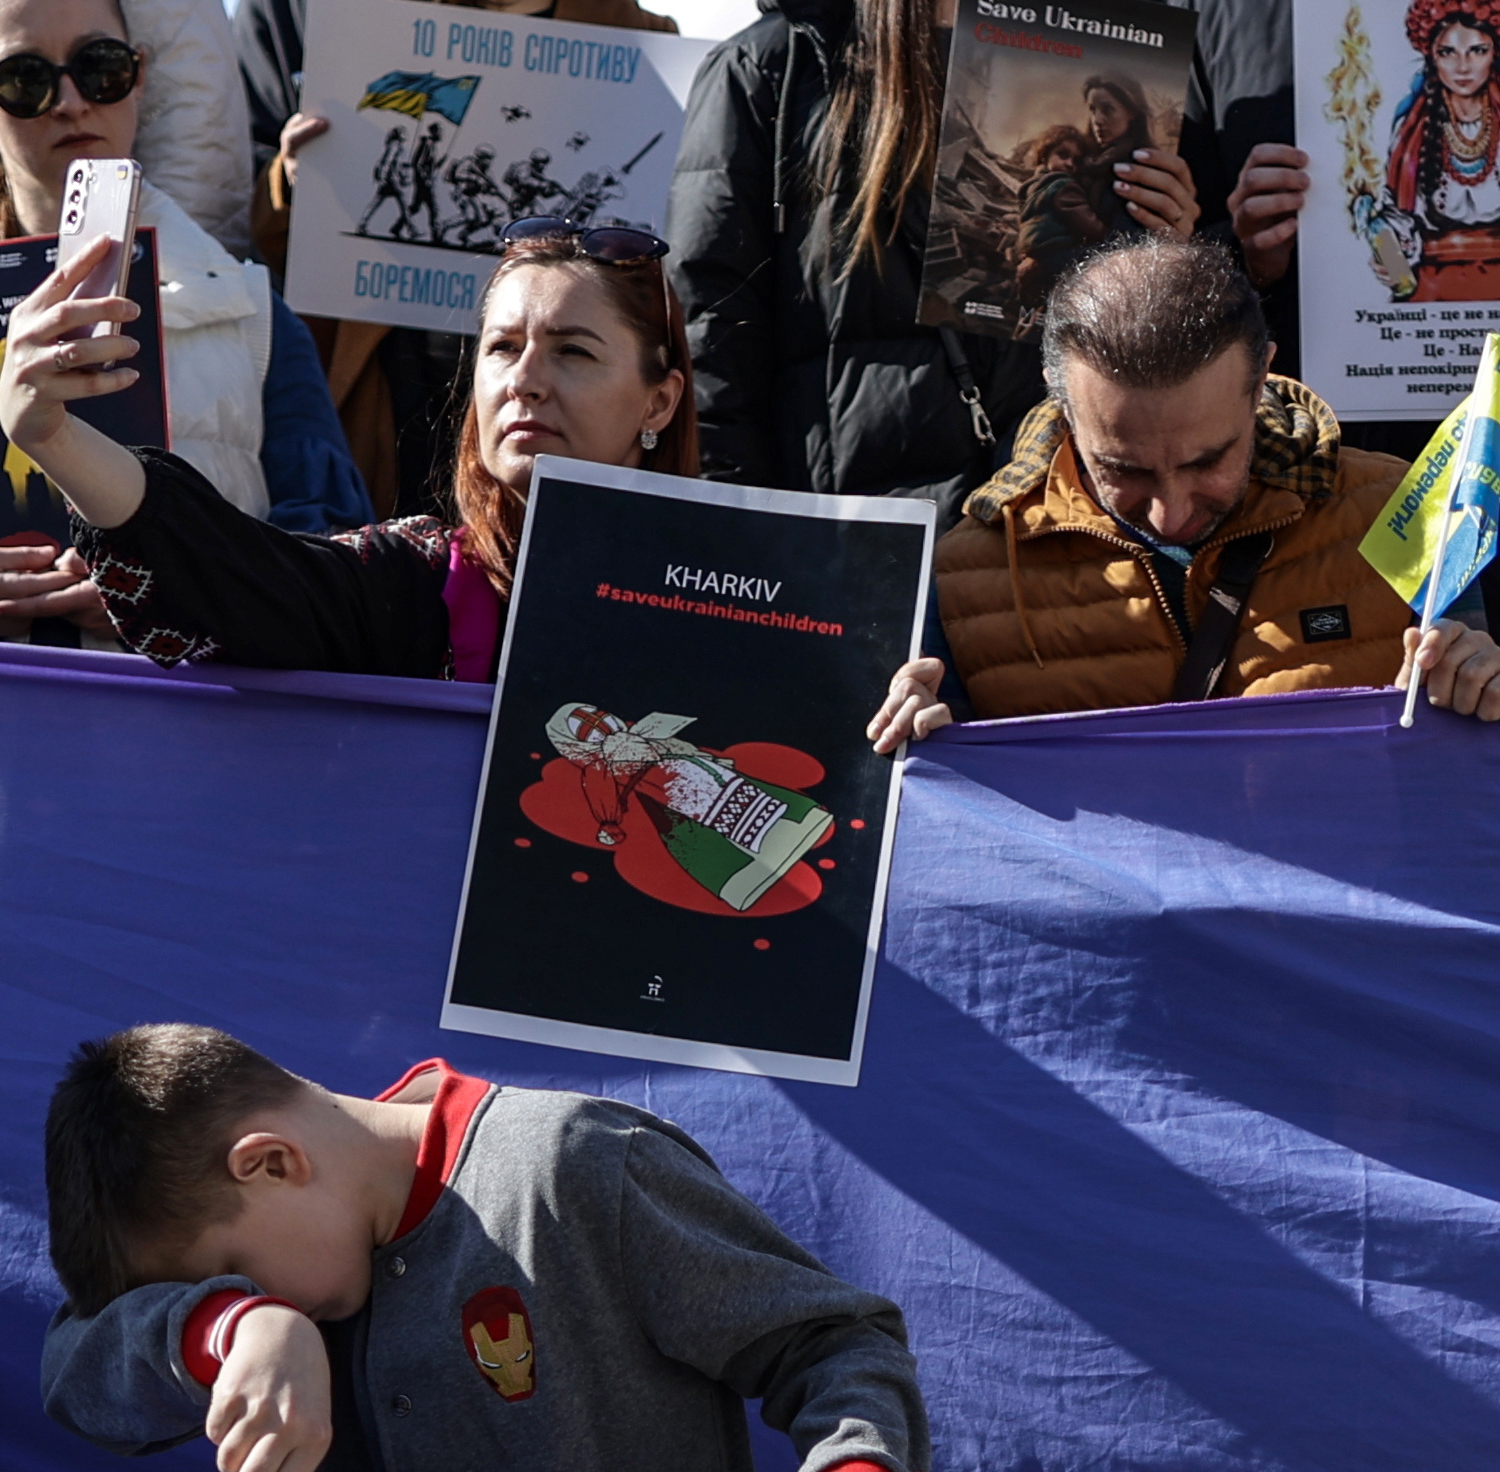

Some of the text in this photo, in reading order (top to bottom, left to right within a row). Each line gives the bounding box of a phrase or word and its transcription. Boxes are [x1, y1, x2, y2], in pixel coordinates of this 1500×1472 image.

[974, 21, 1083, 59] Children
[976, 0, 1165, 48] Save Ukrainian
[412, 18, 641, 84] 10 РОКІВ СПРОТИВУ
[354, 260, 476, 310] БОРЕМОСЯ
[1355, 307, 1427, 324] Українці
[1440, 310, 1459, 322] це
[1464, 310, 1484, 320] не
[1380, 327, 1402, 341] Це
[1415, 328, 1435, 339] не
[1346, 363, 1394, 378] Нація
[1423, 343, 1445, 359] Це
[1387, 439, 1456, 542] перемоги!
[664, 563, 782, 602] KHARKIV
[596, 583, 843, 636] #saveukrainianchildren
